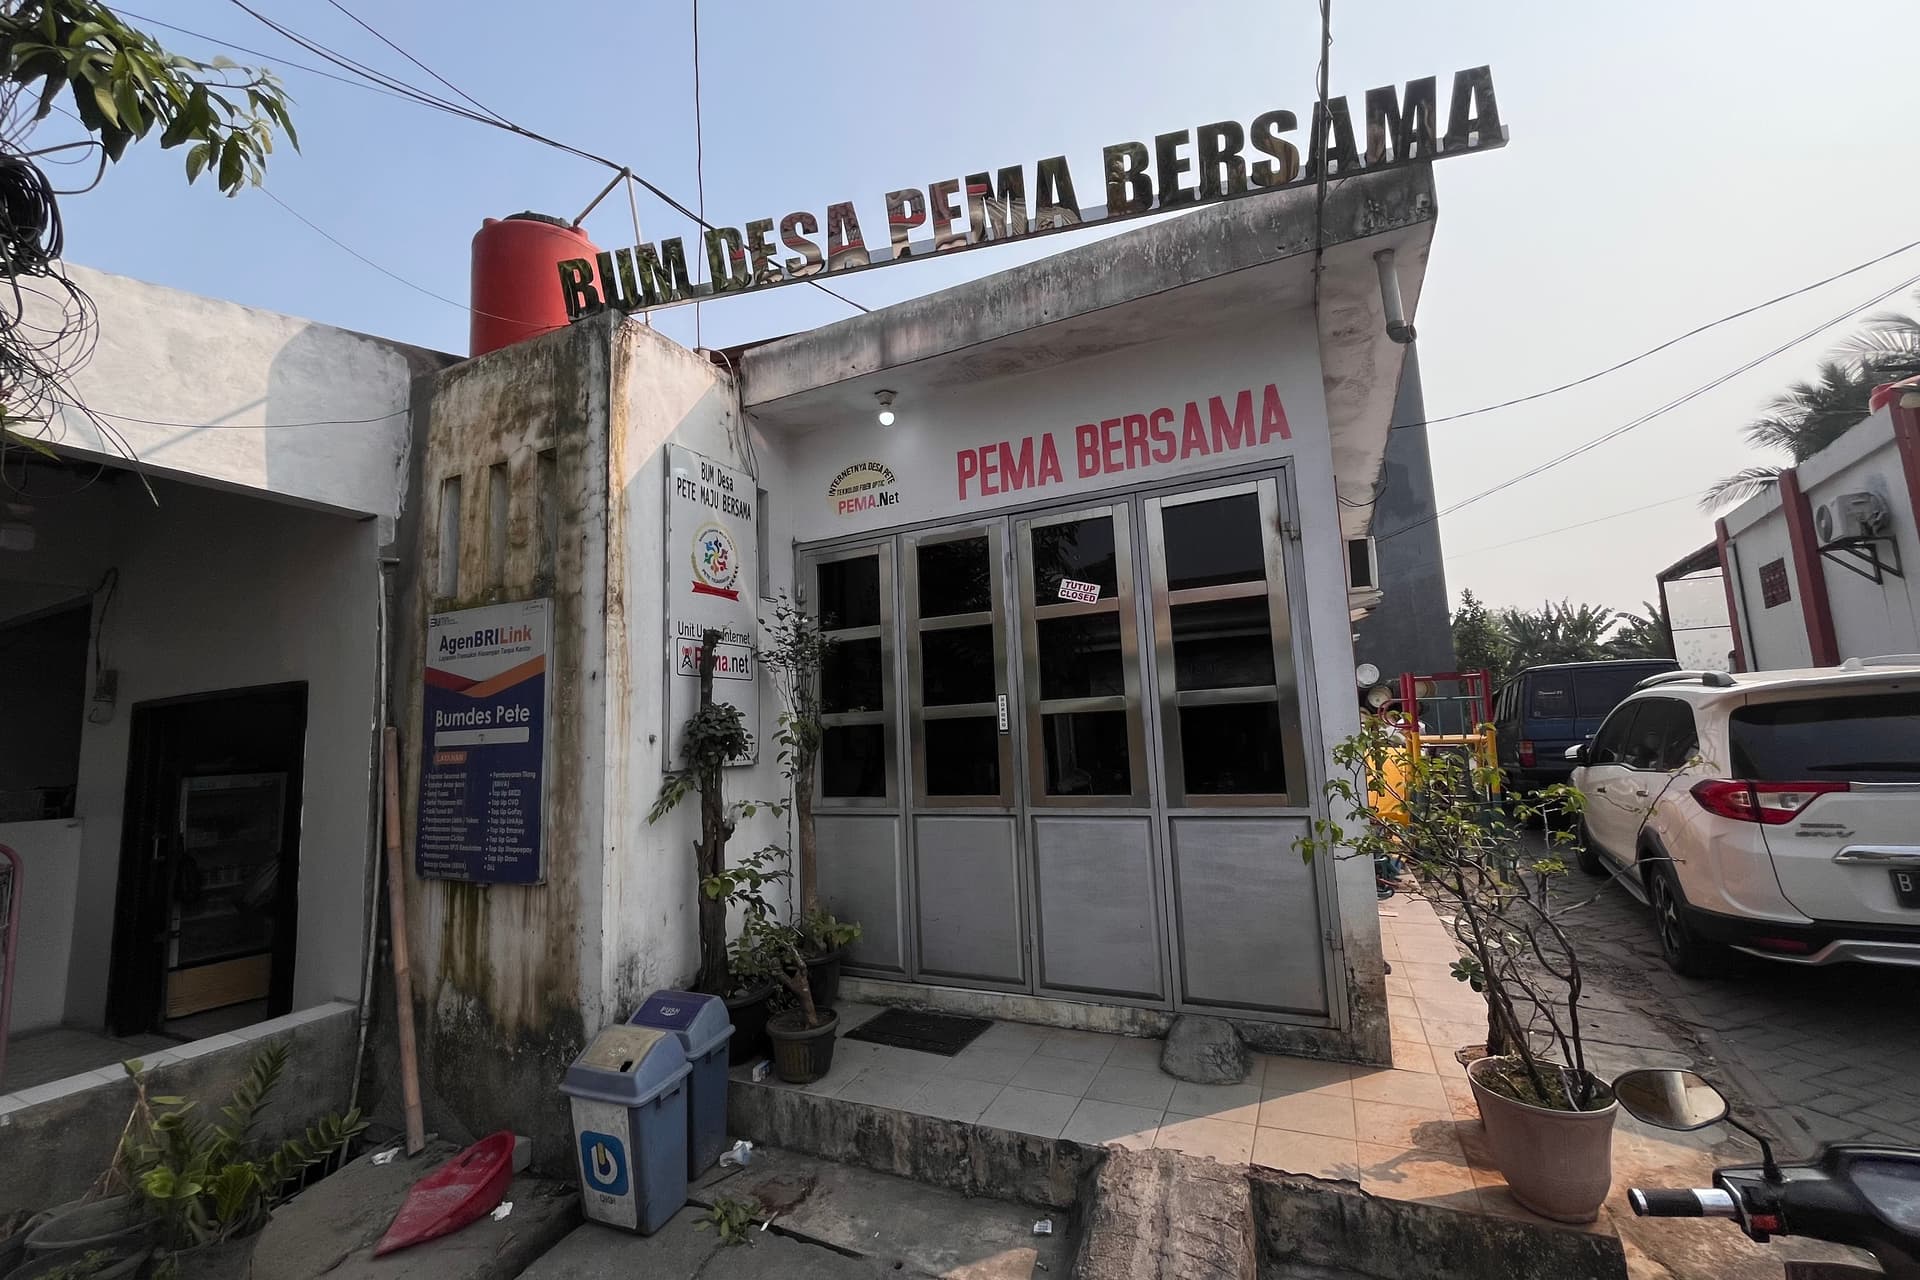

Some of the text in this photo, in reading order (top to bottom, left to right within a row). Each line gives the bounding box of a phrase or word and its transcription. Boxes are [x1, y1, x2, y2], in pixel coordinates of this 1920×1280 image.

[557, 65, 1506, 319] BUM DESA PEMA BERSAMA
[957, 383, 1292, 500] PEMA BERSAMA
[701, 461, 734, 491] BUM Desa
[828, 461, 896, 497] INTERNETNYA DESA PETE
[676, 476, 752, 521] PETE MAJU BERSAMA
[838, 491, 900, 515] PEMA.Net
[1060, 589, 1097, 603] CLOSED
[1065, 580, 1096, 593] TUTUP
[439, 624, 533, 655] AgenBRILink
[677, 620, 696, 637] Unit
[722, 627, 751, 645] Internet
[435, 703, 530, 728] Bumdes Pete
[1896, 873, 1913, 892] B
